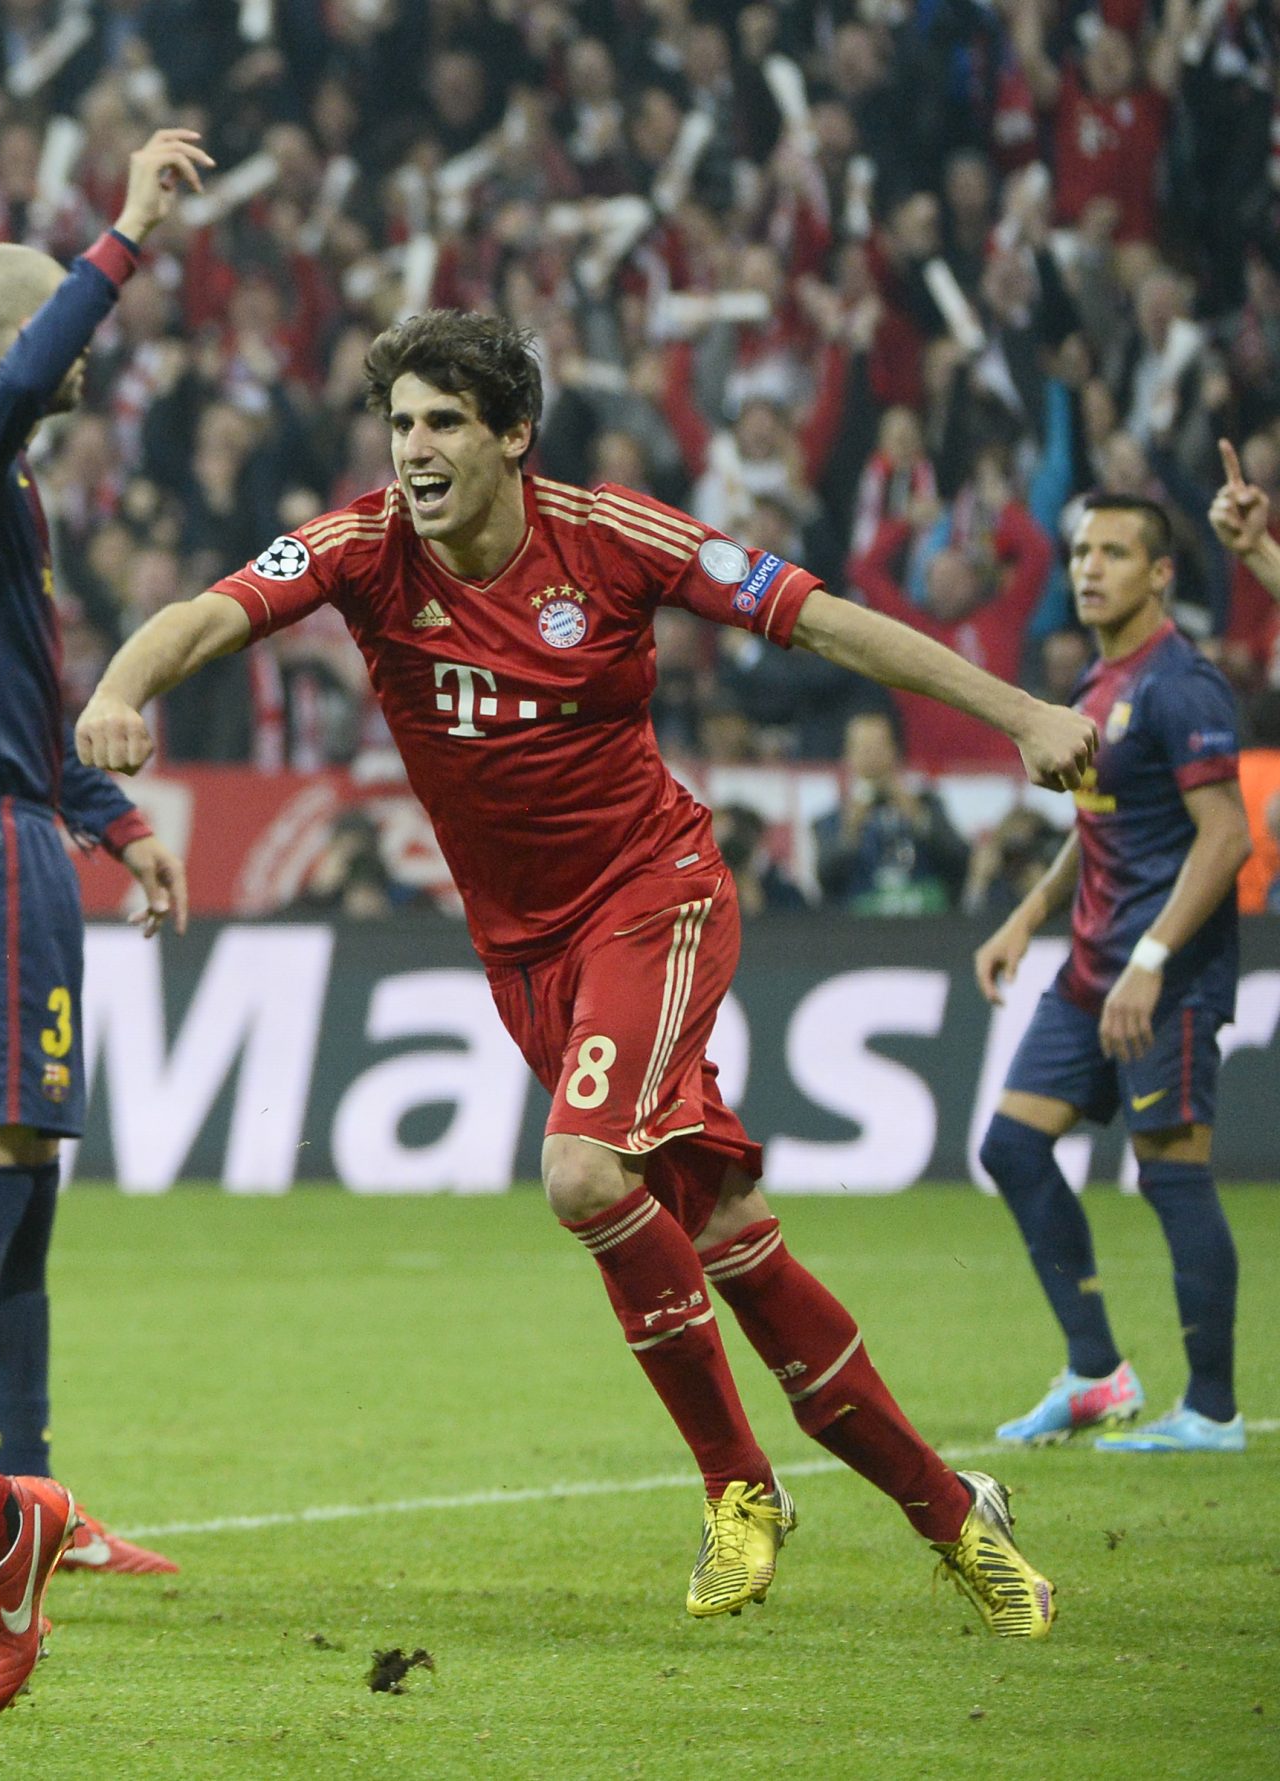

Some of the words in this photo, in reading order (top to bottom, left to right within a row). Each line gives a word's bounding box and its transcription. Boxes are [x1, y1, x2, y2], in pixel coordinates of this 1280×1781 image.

[412, 617, 452, 628] adidas
[40, 986, 72, 1058] 3
[565, 1035, 617, 1109] 8
